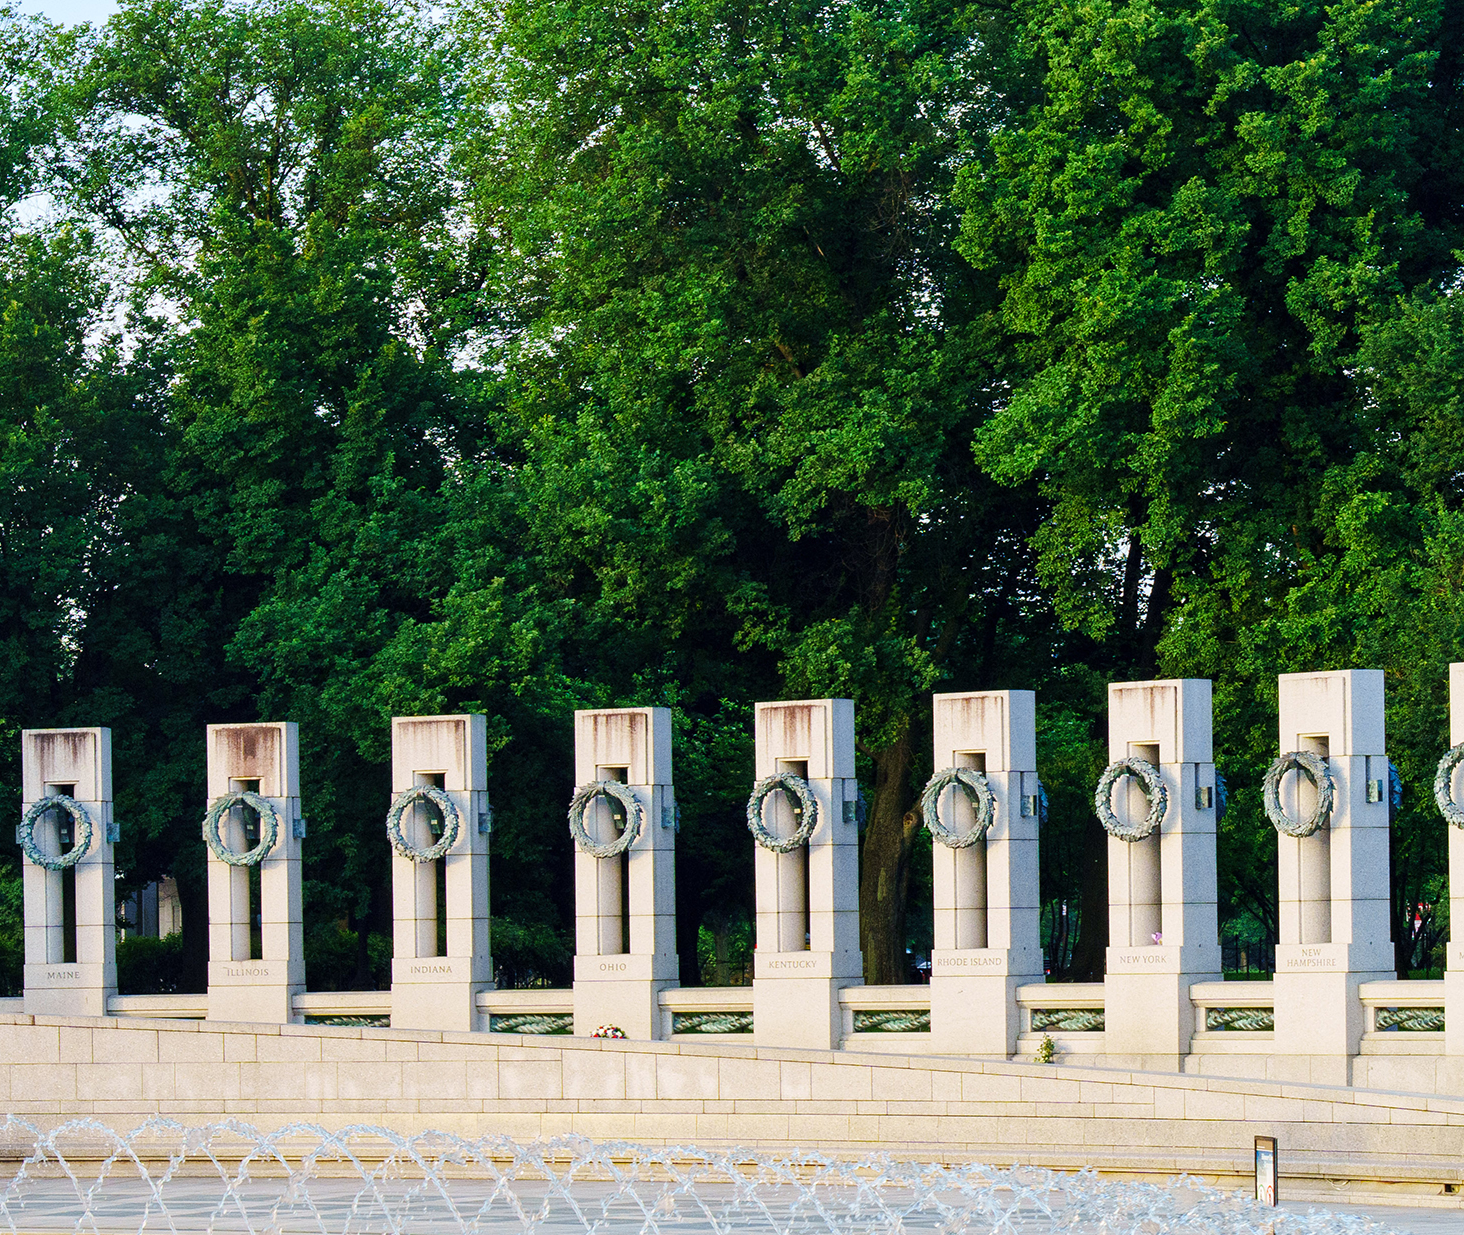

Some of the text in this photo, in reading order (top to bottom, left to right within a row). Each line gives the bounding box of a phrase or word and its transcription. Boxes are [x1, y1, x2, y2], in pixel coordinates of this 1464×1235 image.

[1301, 948, 1322, 957] NEW
[937, 957, 1002, 967] RHODE ISLAND
[1119, 954, 1167, 964] NEW YORK
[1286, 958, 1336, 967] HAMPSHIRE
[599, 962, 627, 971] OHIO
[768, 960, 817, 969] KENTUCKY
[226, 968, 269, 977] ILLINOIS
[410, 966, 453, 974] INDIANA
[47, 971, 80, 980] MAINE
